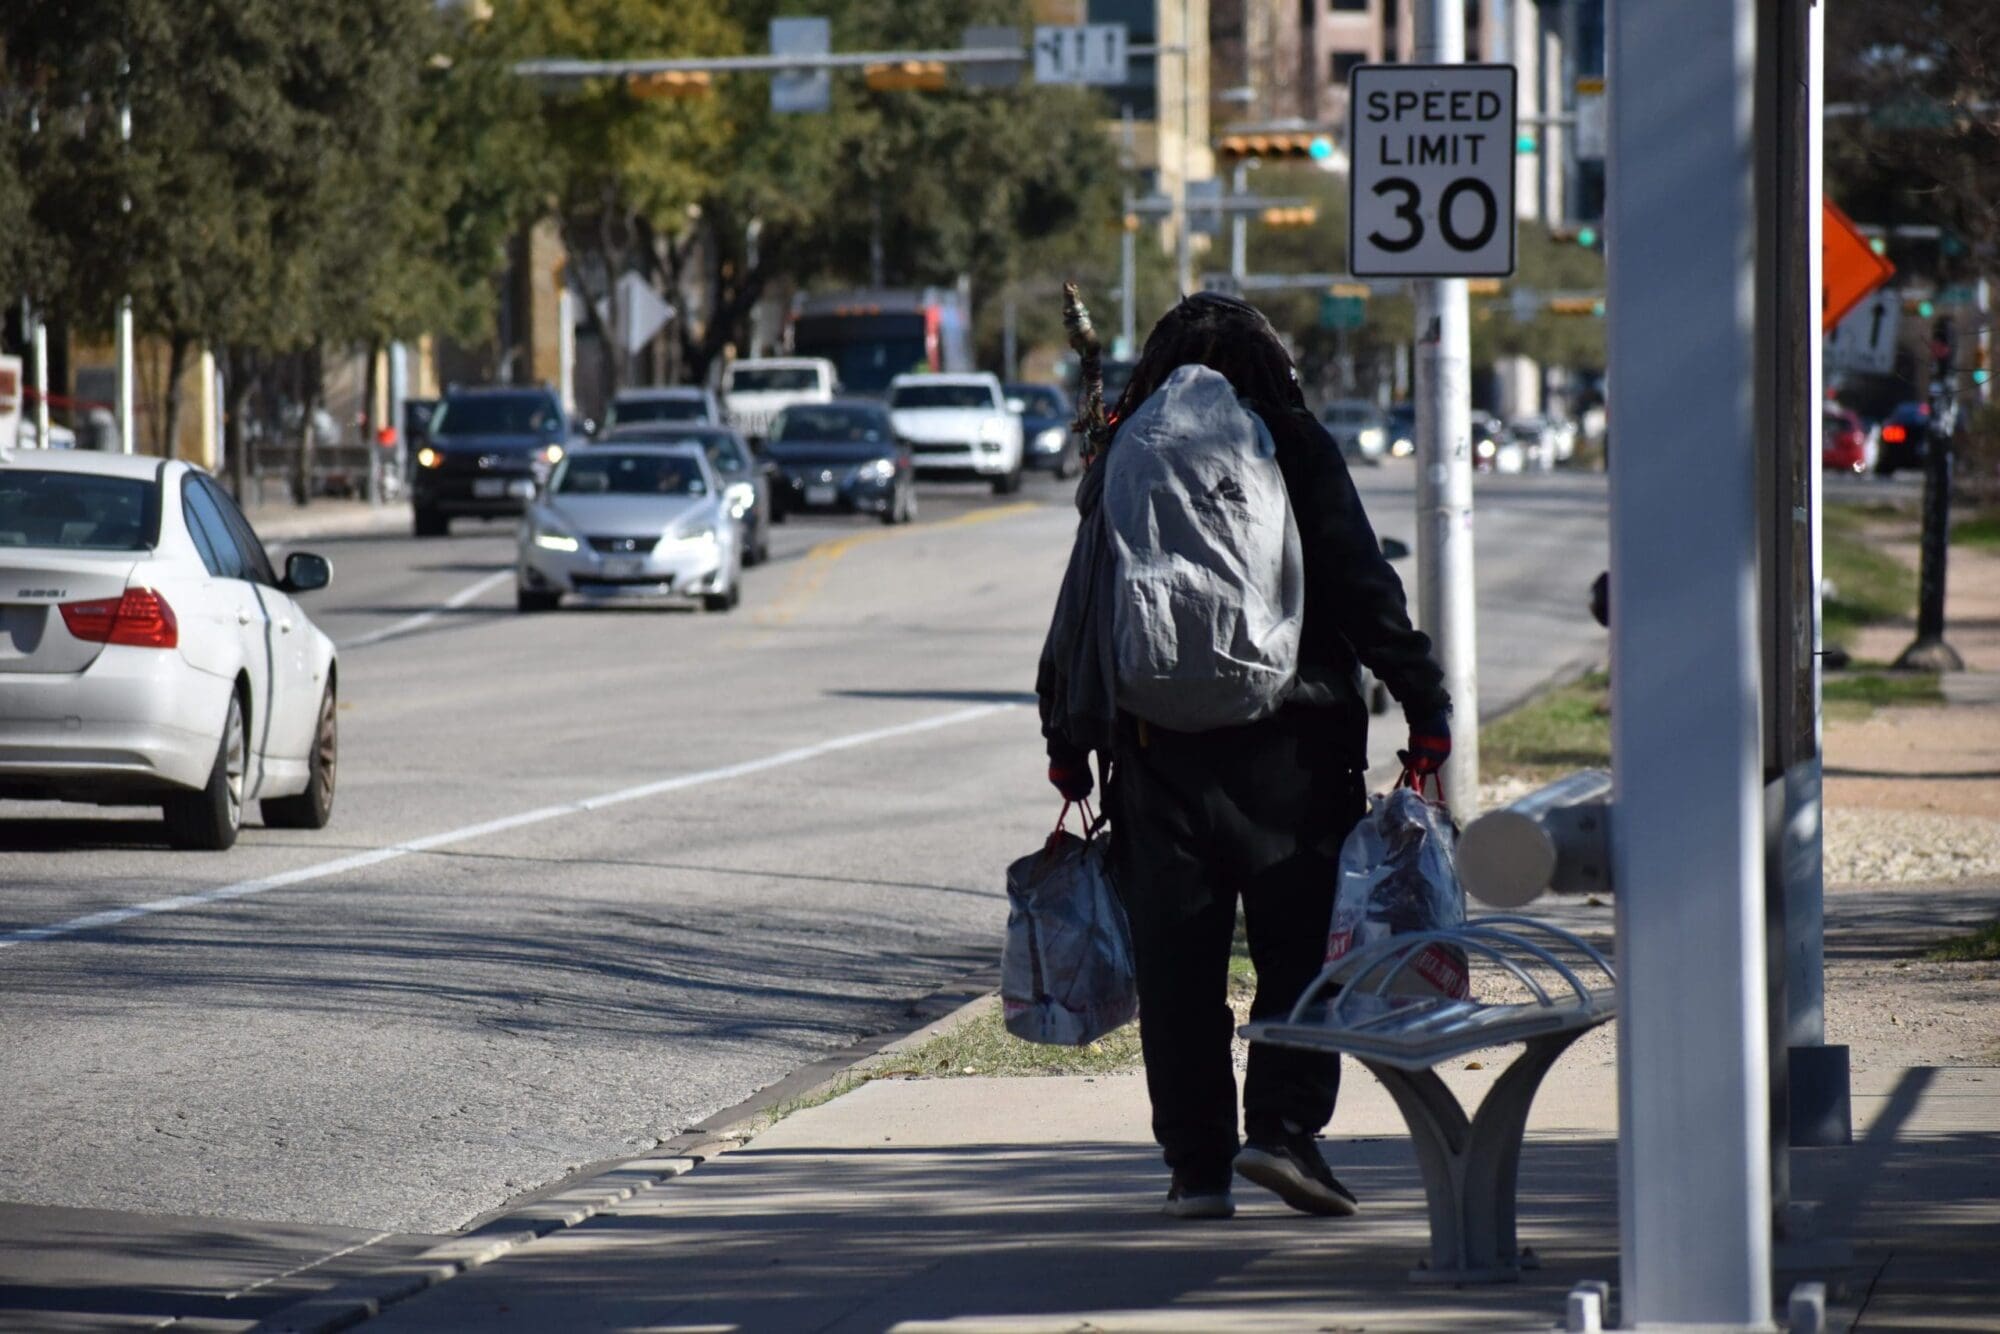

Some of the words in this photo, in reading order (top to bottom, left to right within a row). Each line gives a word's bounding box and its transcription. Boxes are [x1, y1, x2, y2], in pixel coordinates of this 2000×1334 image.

[1367, 91, 1501, 122] SPEED
[1380, 134, 1486, 166] LIMIT
[1367, 177, 1498, 253] 30
